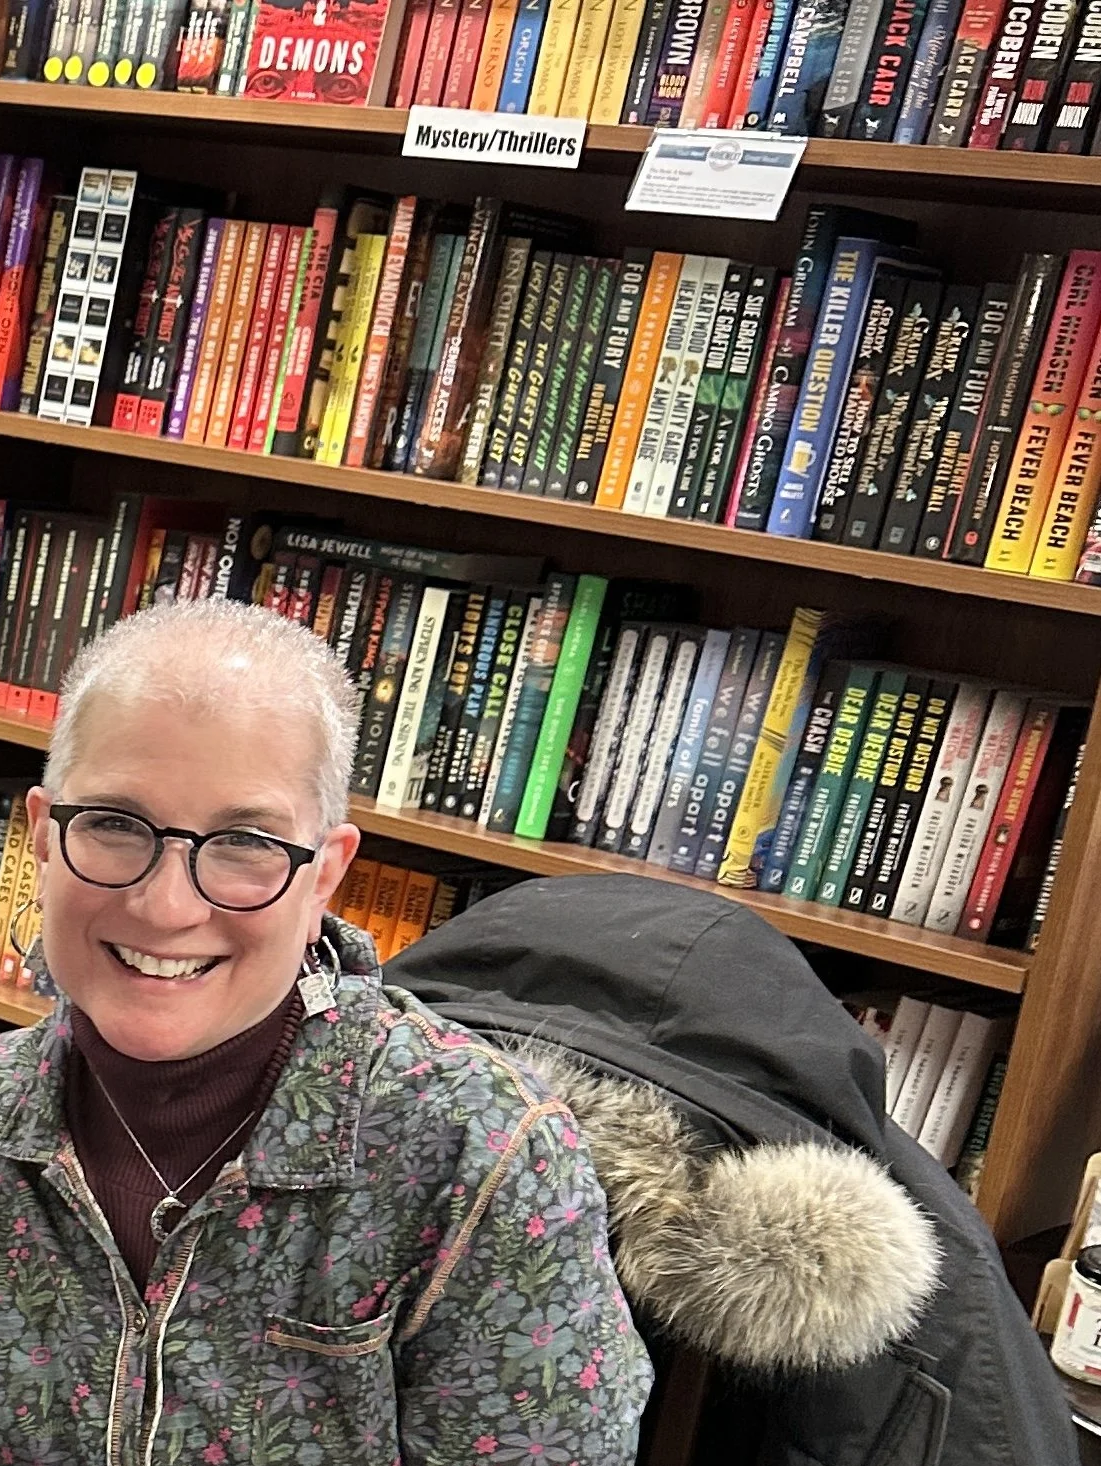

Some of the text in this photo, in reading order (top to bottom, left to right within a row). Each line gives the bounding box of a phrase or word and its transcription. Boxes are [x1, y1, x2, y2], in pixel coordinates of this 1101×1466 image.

[258, 35, 367, 75] DEMONS
[511, 28, 533, 85] ORIGIN
[778, 6, 816, 98] CAMPBELL
[868, 0, 913, 107] JACK CARR
[990, 6, 1032, 81] COBEN
[1030, 0, 1070, 60] COBEN
[942, 38, 977, 119] JACK CARR
[1011, 102, 1044, 126] AWAY
[1056, 104, 1089, 129] AWAY
[415, 125, 577, 157] Mystery/Thrillers
[372, 199, 415, 336] JANET EVANOVICH
[465, 210, 486, 274] VINCE
[603, 262, 645, 369] FOG AND FURY
[705, 290, 741, 370] SUE GRAFTON
[729, 294, 765, 375] SUE GRAFTON
[783, 257, 814, 329] GRISHAM
[858, 299, 886, 359] HENDRIX
[875, 307, 896, 356] GRADY
[649, 280, 698, 426] HEARTWOOD AMITY
[671, 282, 720, 427] HEARTWOOD AMITY
[797, 250, 860, 433] THE KILLER QUESTION
[959, 300, 1008, 416] FOG AND FURY
[428, 336, 463, 443] DENIED ACCESS
[489, 366, 524, 464] GUEST LIST
[509, 370, 545, 468] GUEST LIST
[745, 365, 789, 498] CAMINO GHOSTS
[1001, 263, 1095, 542] CARL HIAASEN FEVER BEACH
[1046, 430, 1096, 550] FEVER BEACH
[286, 532, 372, 560] LISA JEWELL
[457, 594, 485, 659] LIGHTS
[483, 605, 523, 720] CLOSE CALL
[362, 710, 384, 777] HOLLY
[464, 684, 483, 718] PLAY
[803, 706, 834, 754] CRASH
[822, 686, 868, 777] DEAR DEBBIE
[854, 692, 899, 784] DEAR DEBBIE
[880, 692, 922, 788] DO NOT DISTURB
[667, 697, 709, 808] family liars
[681, 725, 729, 836] fell apart
[904, 697, 947, 794] DO NOT DISTURB
[706, 779, 736, 843] apart
[15, 858, 35, 909] CASES
